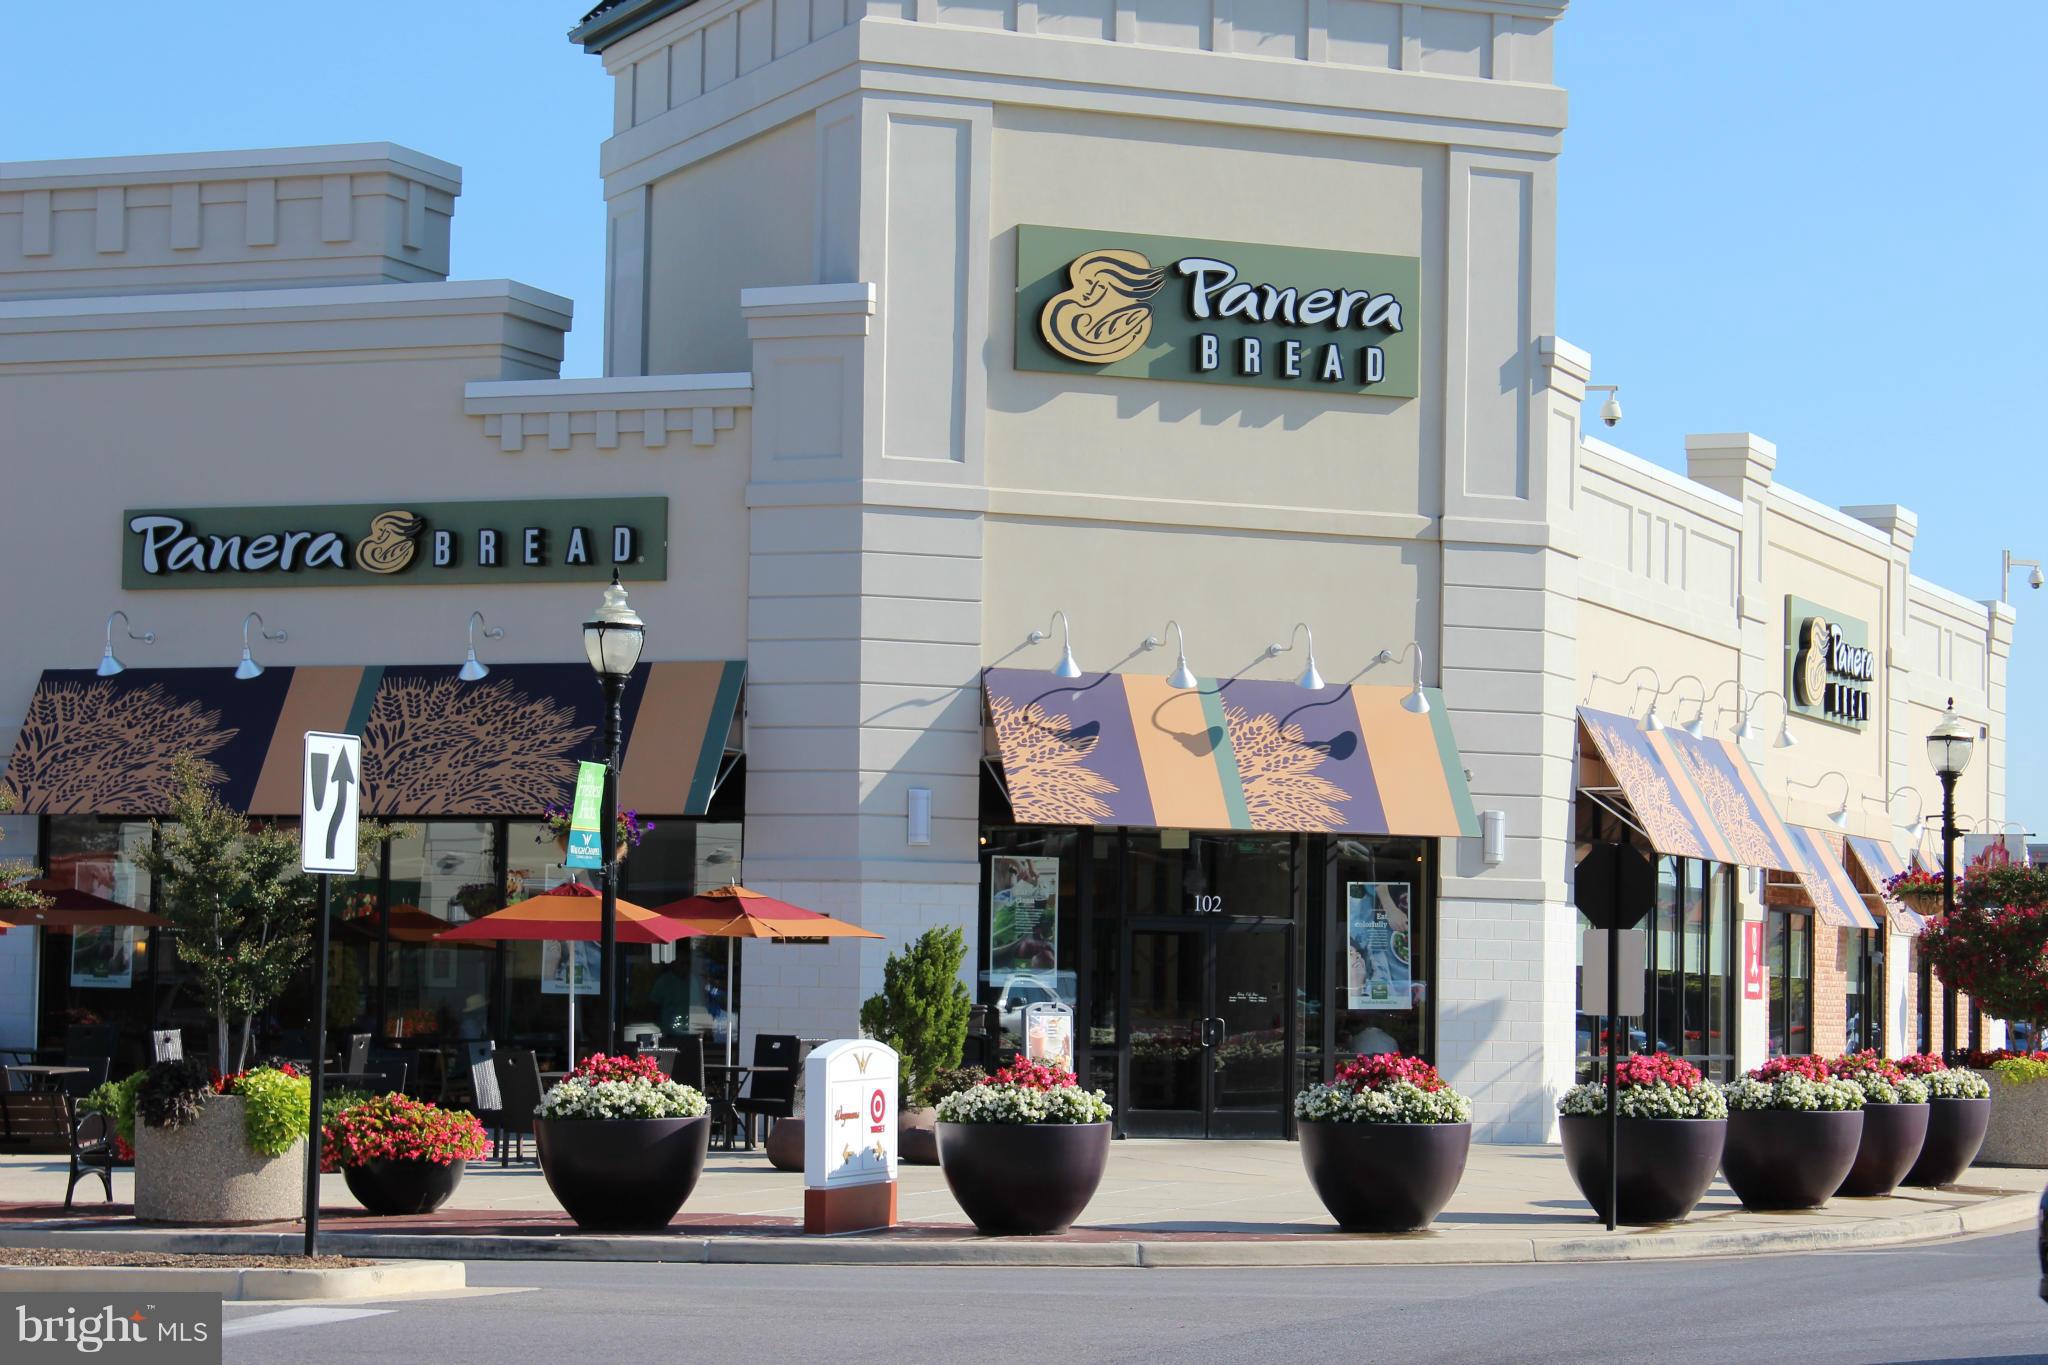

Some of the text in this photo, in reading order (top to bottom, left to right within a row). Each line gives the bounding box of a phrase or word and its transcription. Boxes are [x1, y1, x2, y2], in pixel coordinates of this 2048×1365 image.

[1177, 256, 1403, 332] Panera
[1201, 333, 1384, 384] BREAD
[129, 514, 634, 573] Panera BREAD
[1829, 624, 1874, 681] Panera
[1194, 895, 1222, 912] 102
[1354, 920, 1388, 928] colorfully
